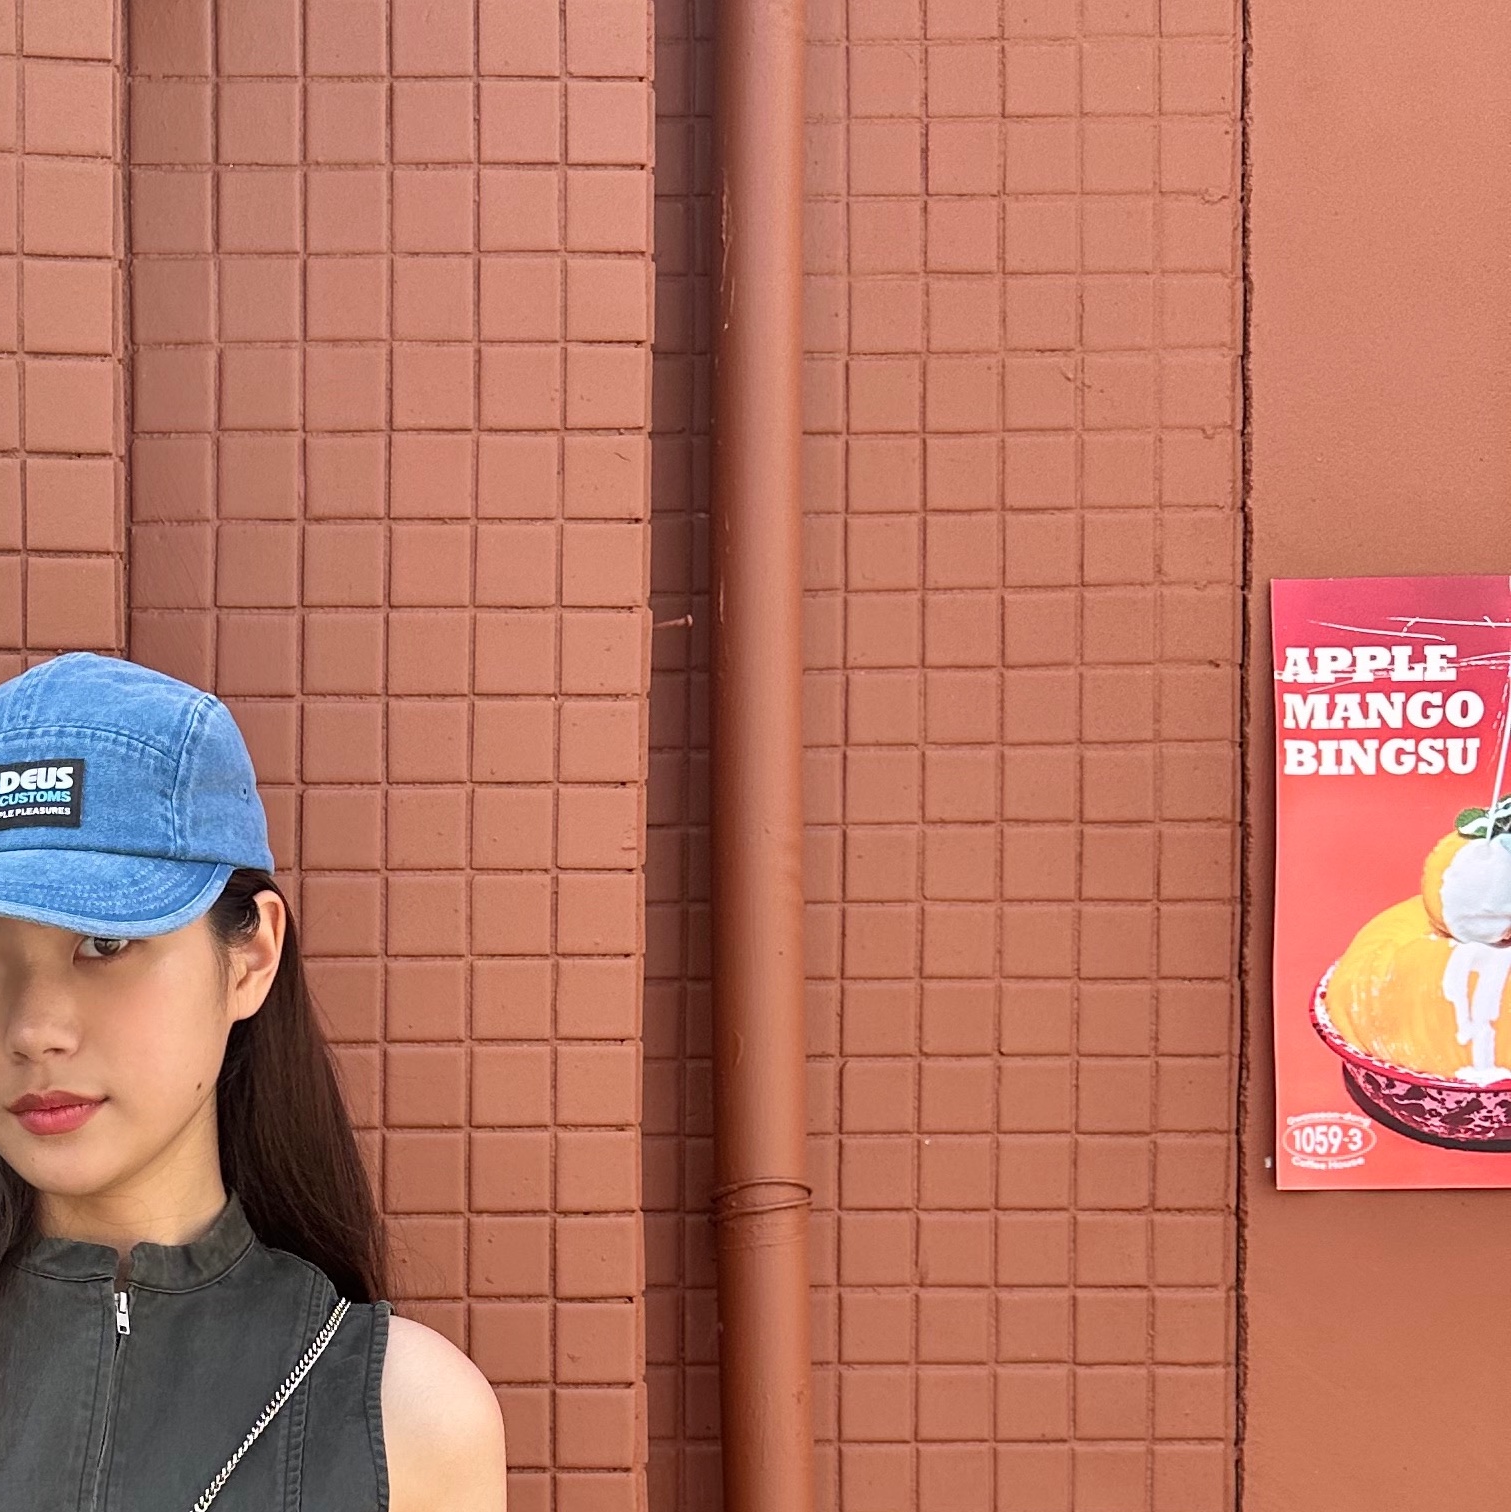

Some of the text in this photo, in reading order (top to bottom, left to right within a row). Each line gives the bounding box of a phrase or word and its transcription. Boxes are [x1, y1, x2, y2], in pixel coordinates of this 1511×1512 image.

[1282, 645, 1457, 683] APPLE
[1283, 690, 1484, 730] MANGO
[1283, 737, 1480, 776] BINGSU
[0, 766, 74, 795] DEUS
[15, 806, 71, 818] PLEASURES
